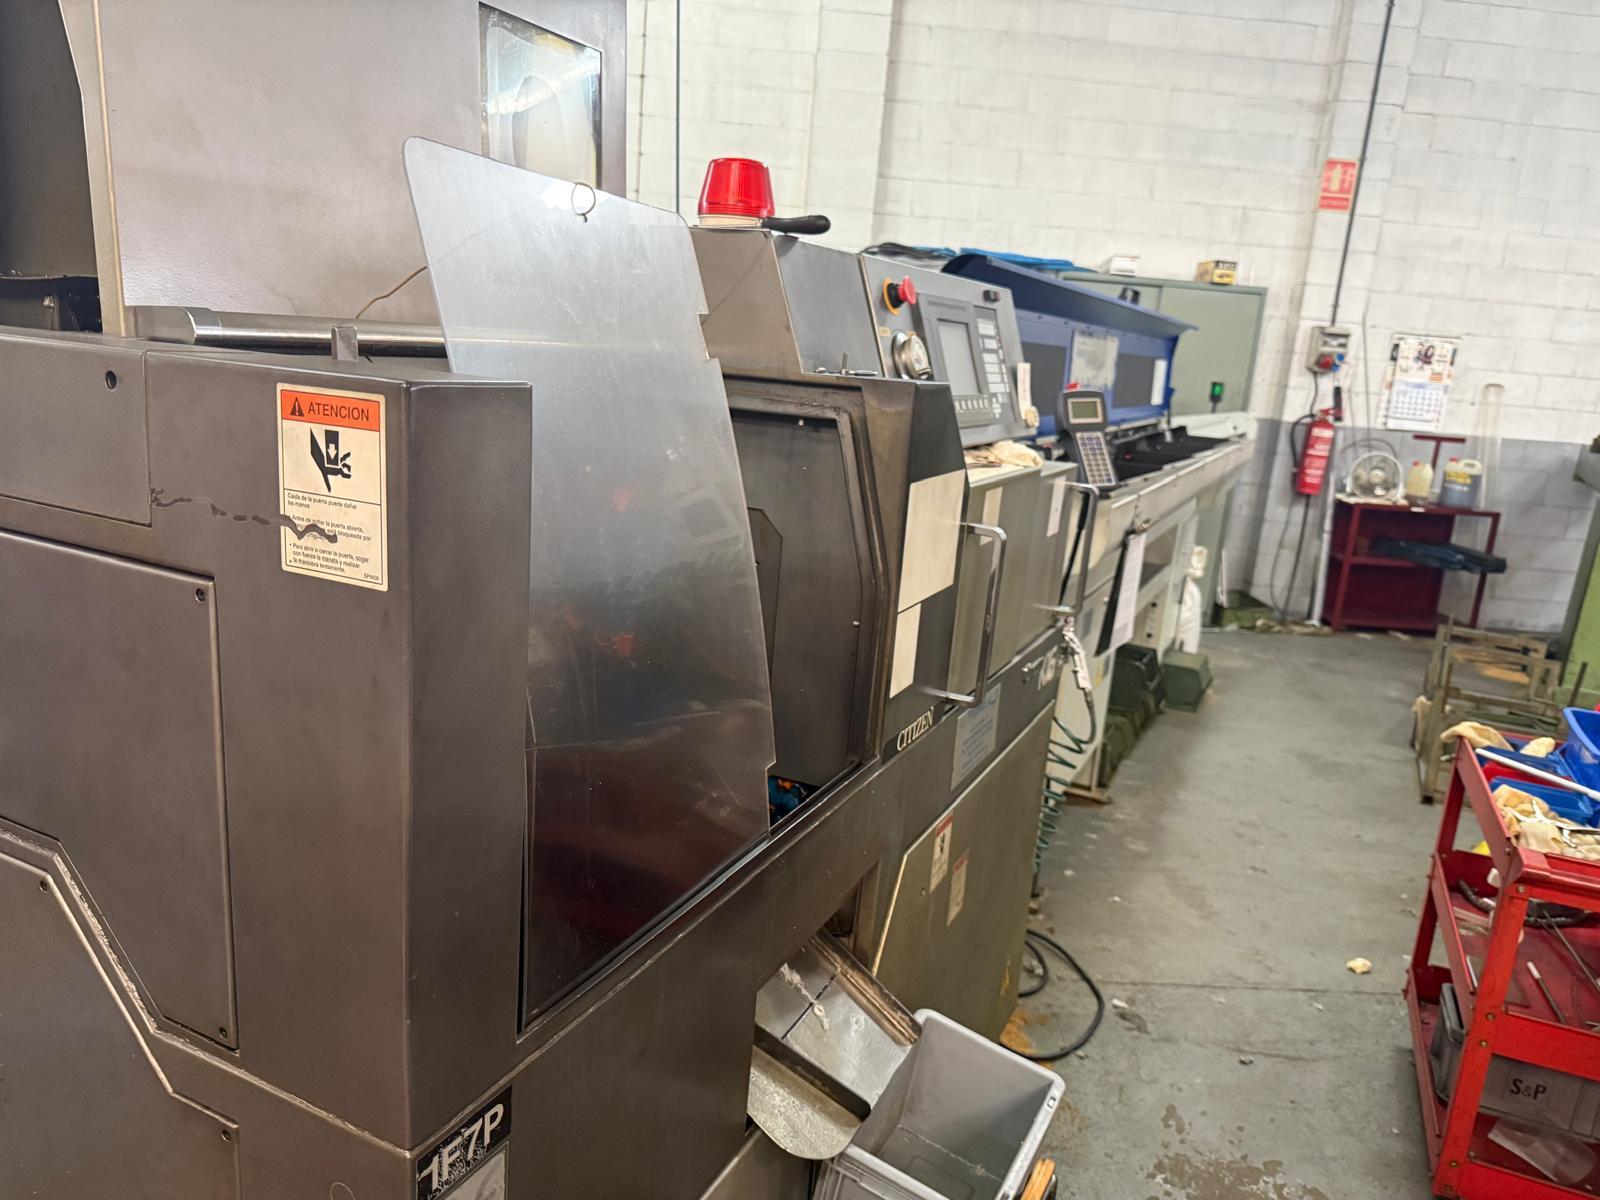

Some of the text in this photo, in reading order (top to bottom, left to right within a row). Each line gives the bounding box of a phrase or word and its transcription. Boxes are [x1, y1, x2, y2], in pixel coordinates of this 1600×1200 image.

[308, 402, 369, 422] ATENCION
[307, 494, 313, 502] la
[313, 496, 328, 505] puerta
[330, 521, 346, 530] puerta
[302, 551, 316, 560] fuerza
[333, 549, 338, 557] la
[897, 705, 934, 751] CITIZEN
[1510, 1078, 1547, 1100] S&P
